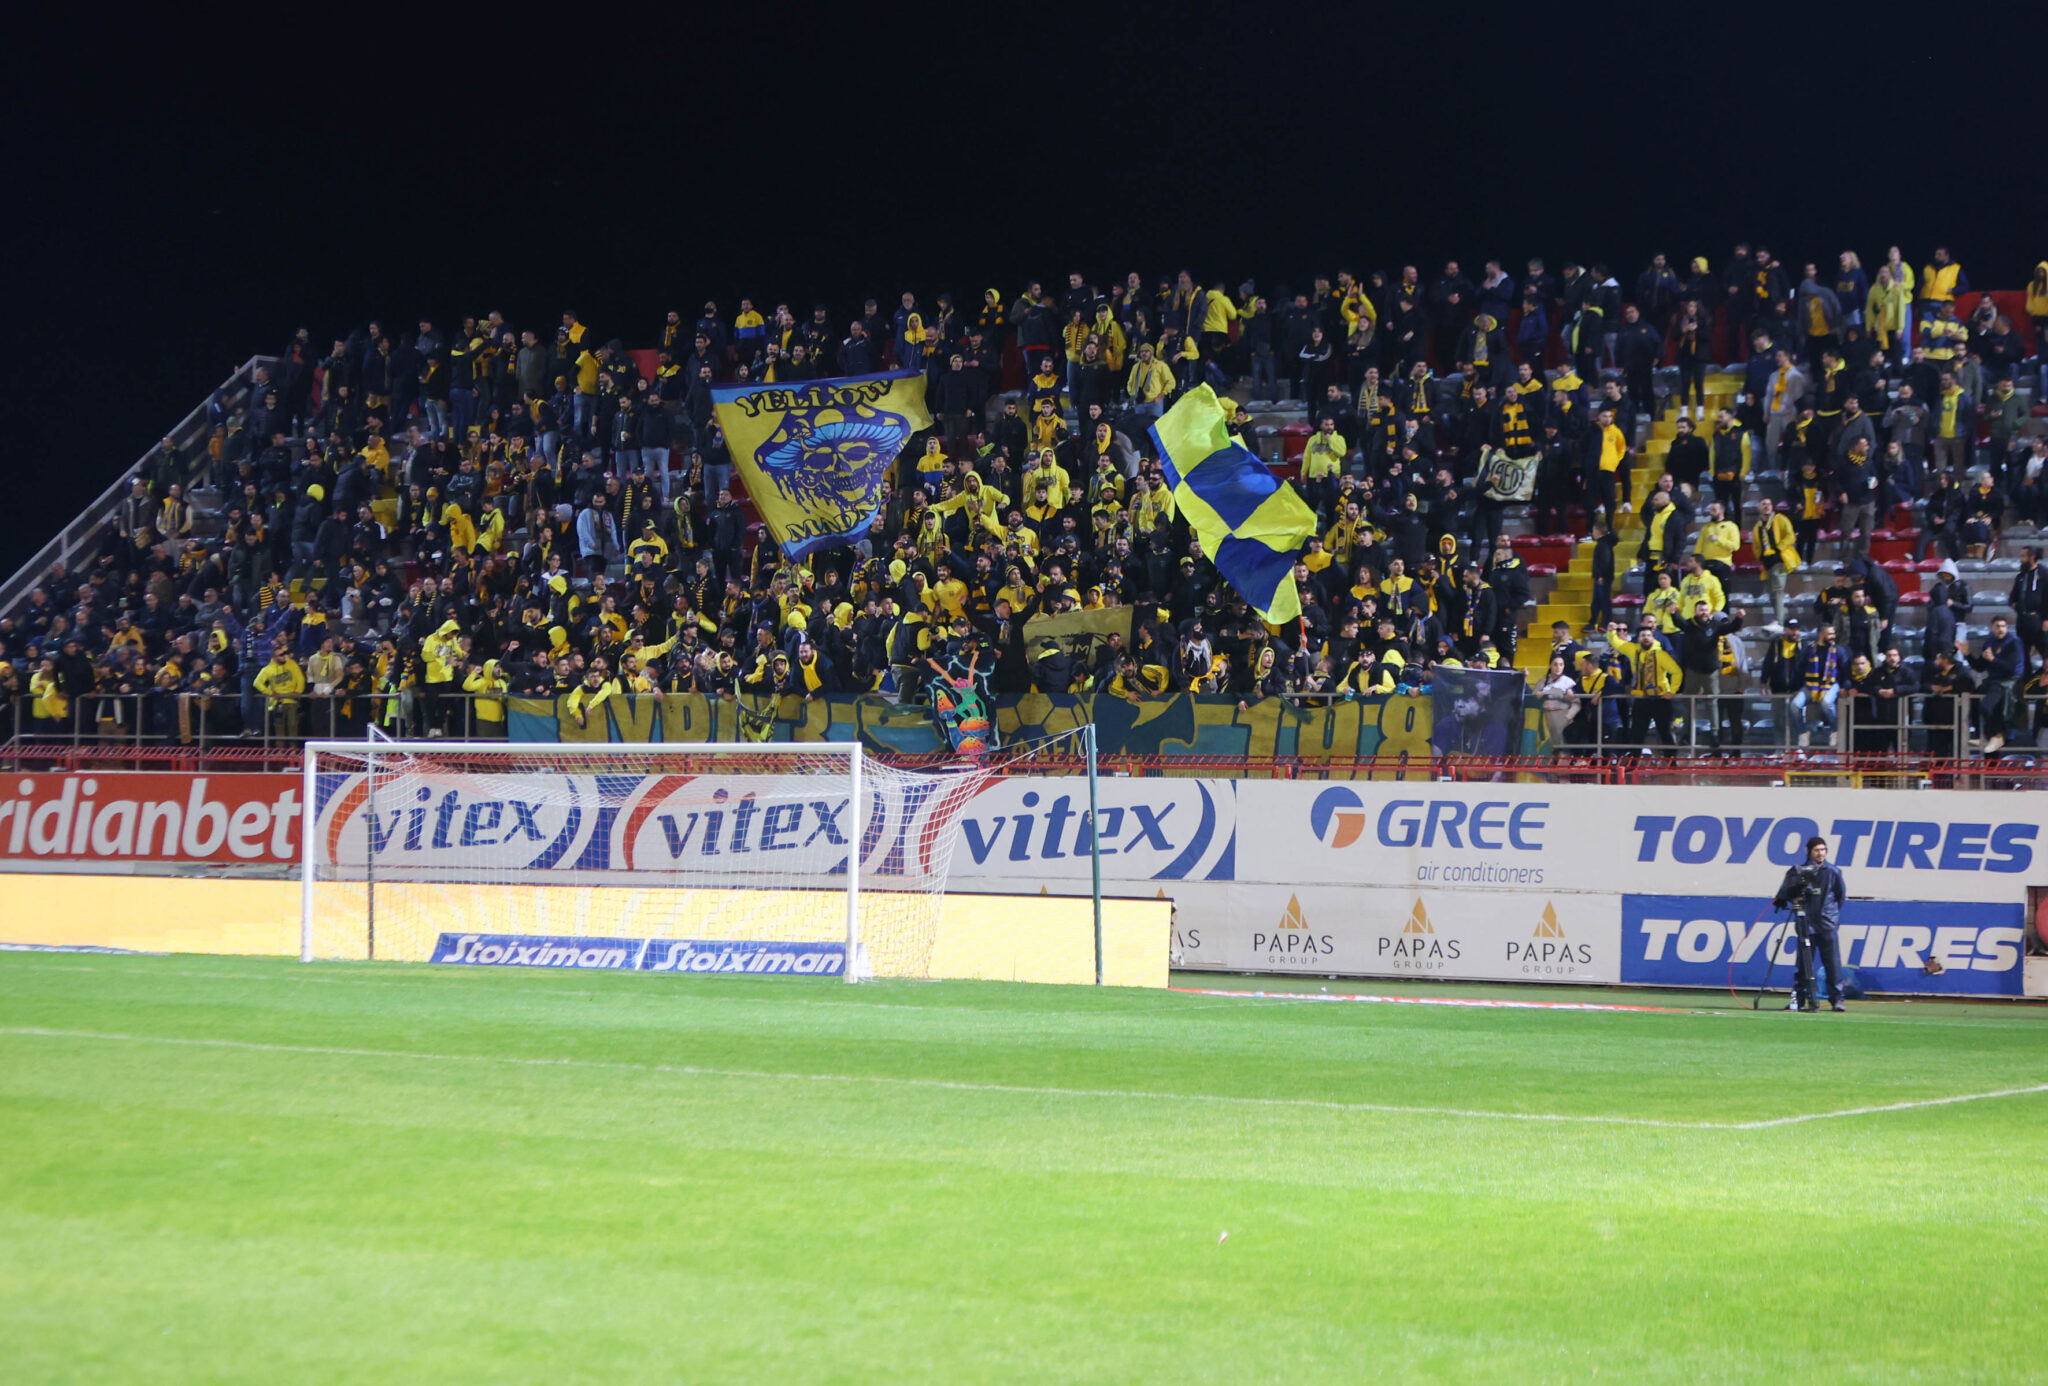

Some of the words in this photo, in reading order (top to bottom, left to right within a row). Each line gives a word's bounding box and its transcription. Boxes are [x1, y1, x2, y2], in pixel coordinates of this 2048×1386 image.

[735, 379, 894, 418] YELLOW
[361, 786, 549, 853] vitex
[657, 787, 850, 858] vitex
[962, 791, 1176, 865] vitex
[1377, 800, 1550, 850] GREE
[1633, 814, 1820, 865] TOYO
[1830, 819, 2040, 873] TIRES
[1417, 861, 1440, 881] air
[1443, 861, 1544, 884] conditioners
[440, 936, 627, 968] Stoiximan
[651, 941, 844, 975] Stoiximan
[1253, 932, 1334, 955] PAPAS
[1268, 955, 1318, 965] GROUP
[1378, 937, 1461, 960] PAPAS
[1507, 941, 1592, 964] PAPAS
[1838, 924, 2024, 972] TIRES
[1393, 960, 1444, 970] GROUP
[1522, 965, 1576, 975] GROUP
